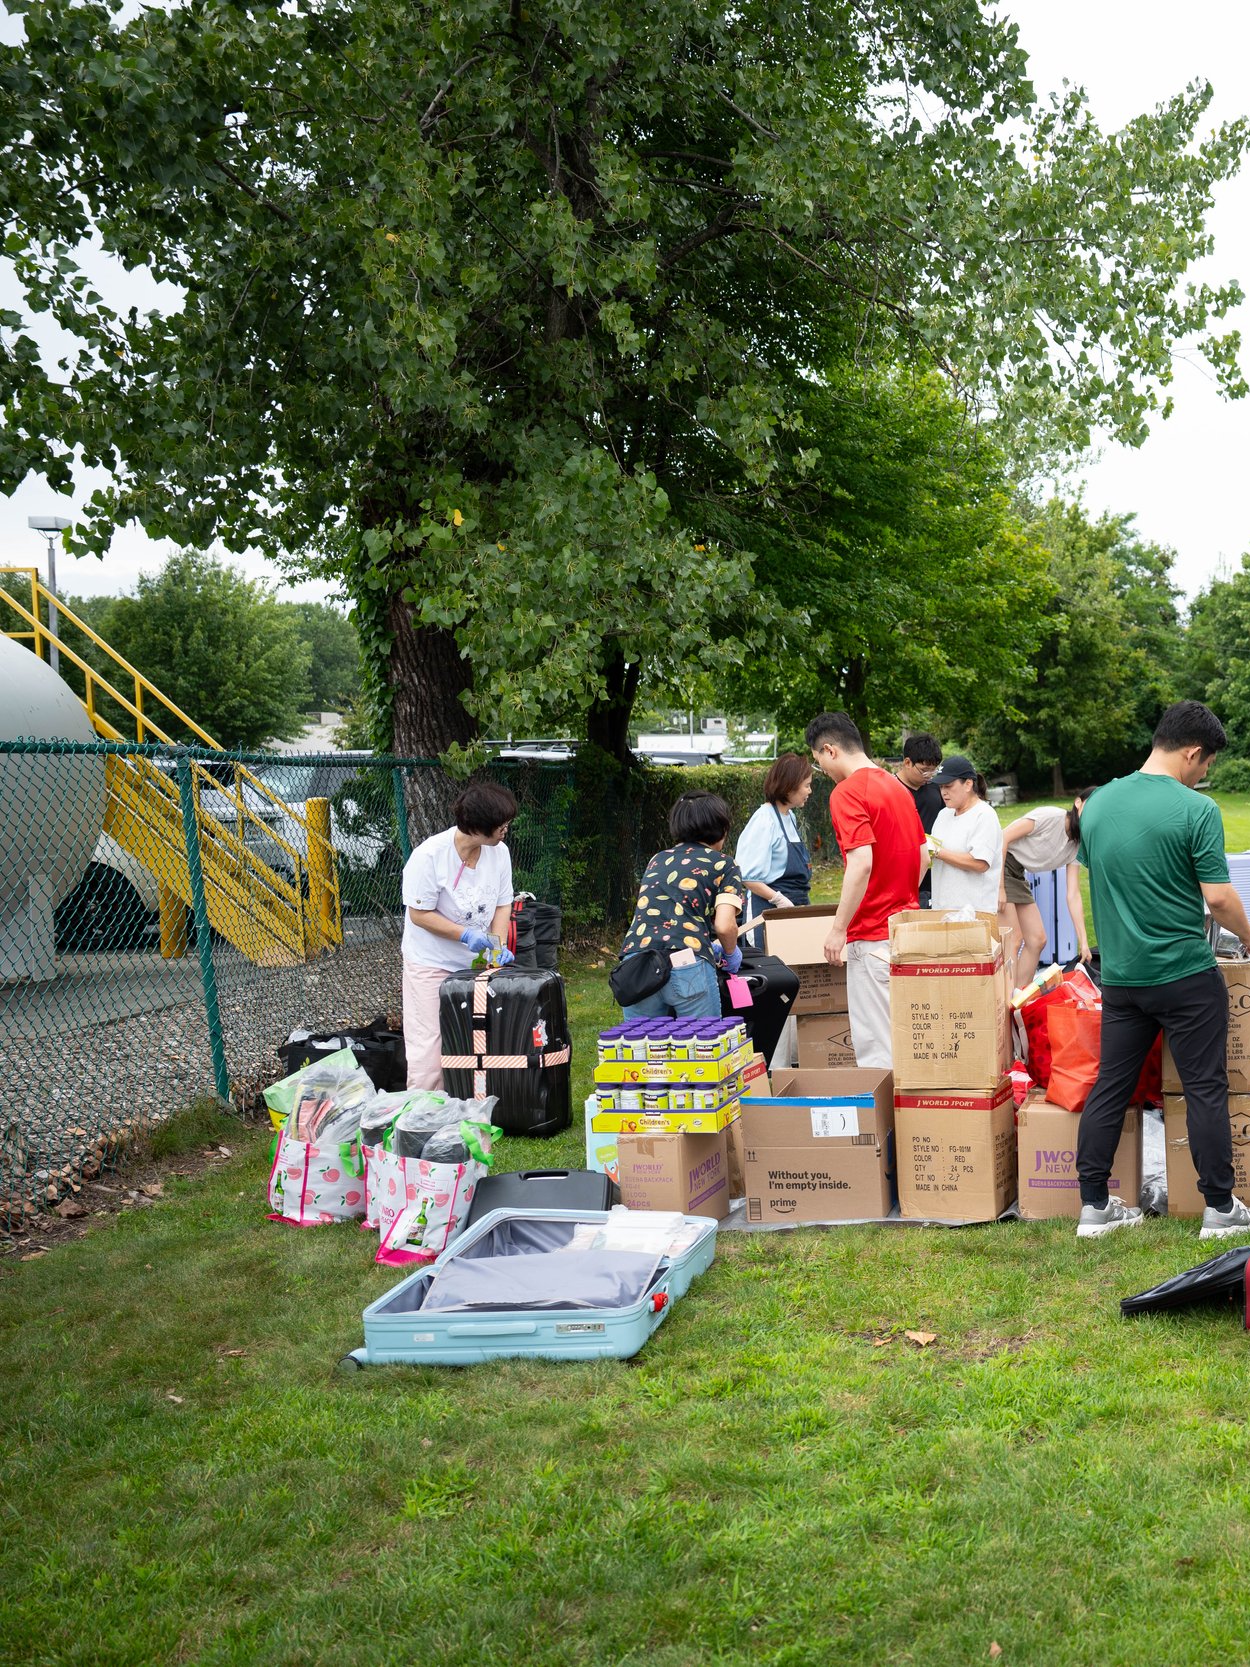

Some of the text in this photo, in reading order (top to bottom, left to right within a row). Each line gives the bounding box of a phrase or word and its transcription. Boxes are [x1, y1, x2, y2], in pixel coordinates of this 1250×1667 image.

[912, 1032, 925, 1040] QTY
[913, 1052, 929, 1060] MADE
[639, 1118, 670, 1126] Children's
[914, 1164, 926, 1172] QTY
[963, 1165, 974, 1173] PCS
[1045, 1164, 1072, 1173] NEW
[768, 1171, 831, 1181] Without you,
[769, 1181, 851, 1191] I'm empty inside.
[770, 1198, 797, 1208] prime
